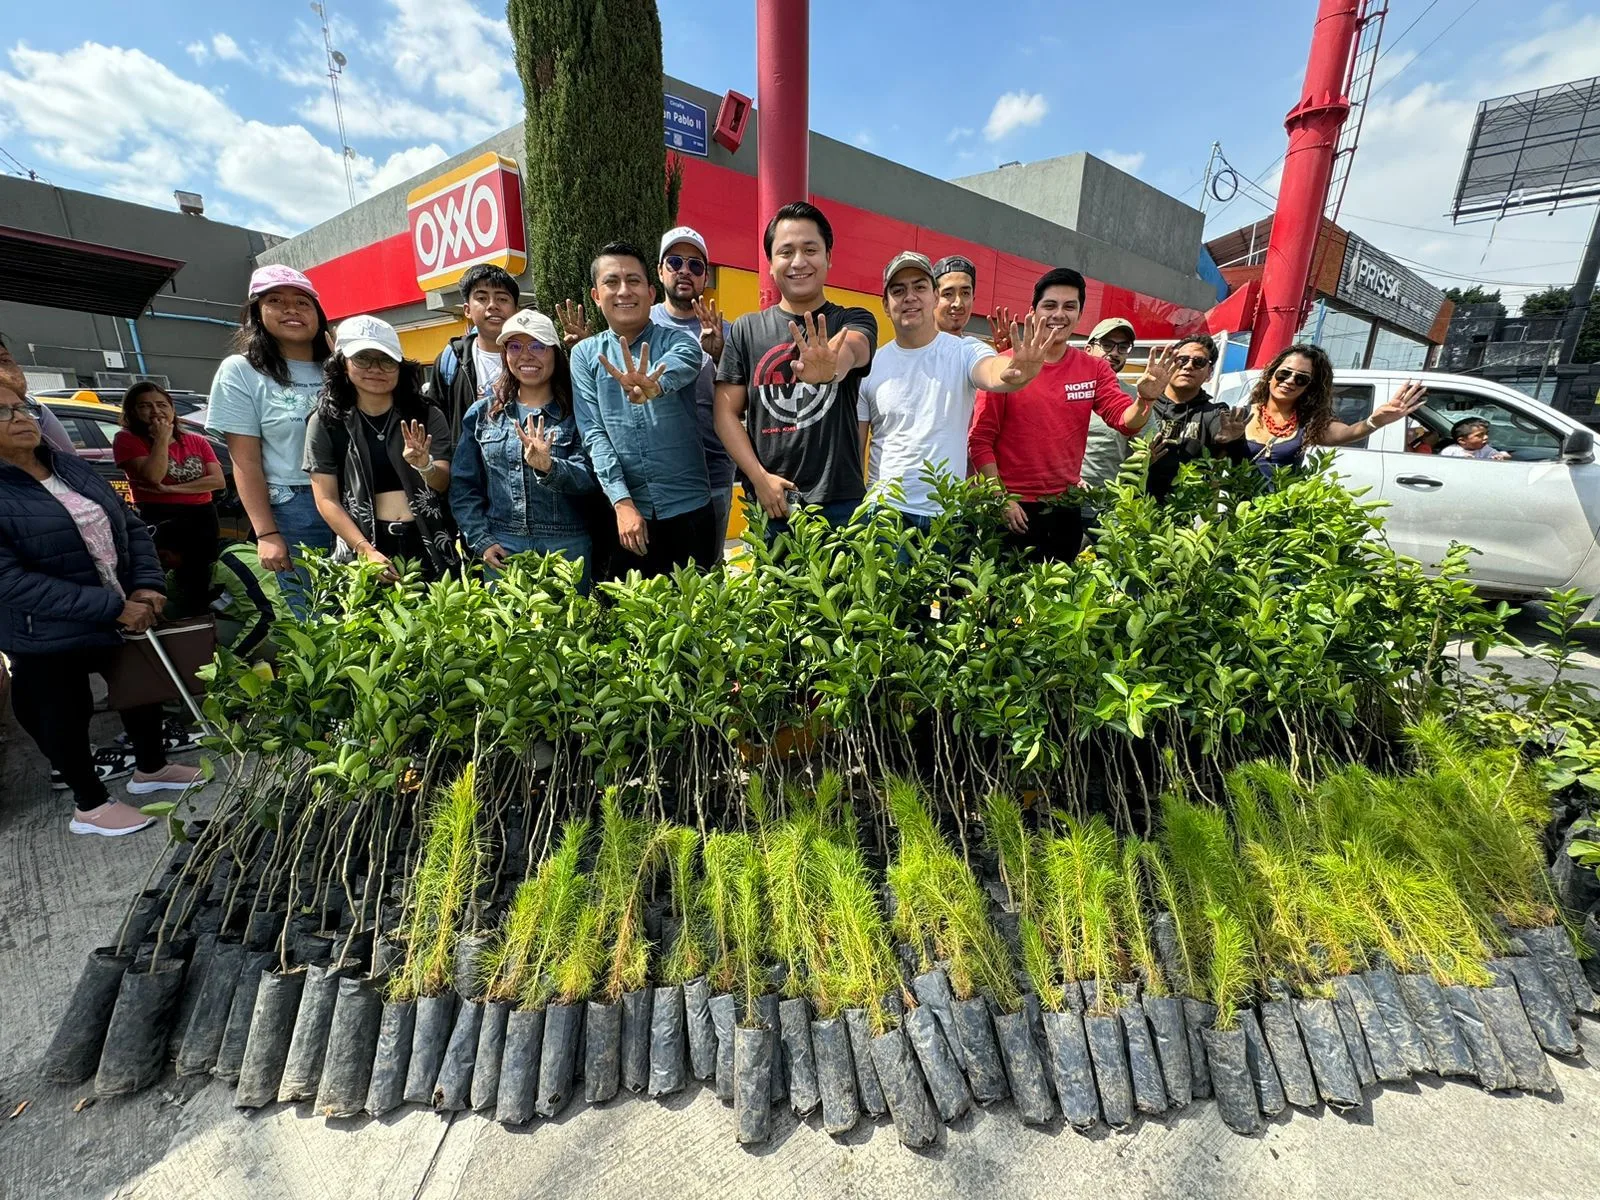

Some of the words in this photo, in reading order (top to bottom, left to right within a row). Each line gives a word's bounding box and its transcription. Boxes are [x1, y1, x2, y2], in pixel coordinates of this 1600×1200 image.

[673, 112, 695, 127] Pablo
[695, 119, 702, 130] II
[415, 180, 499, 270] OXXO
[1357, 259, 1401, 302] PRISSA
